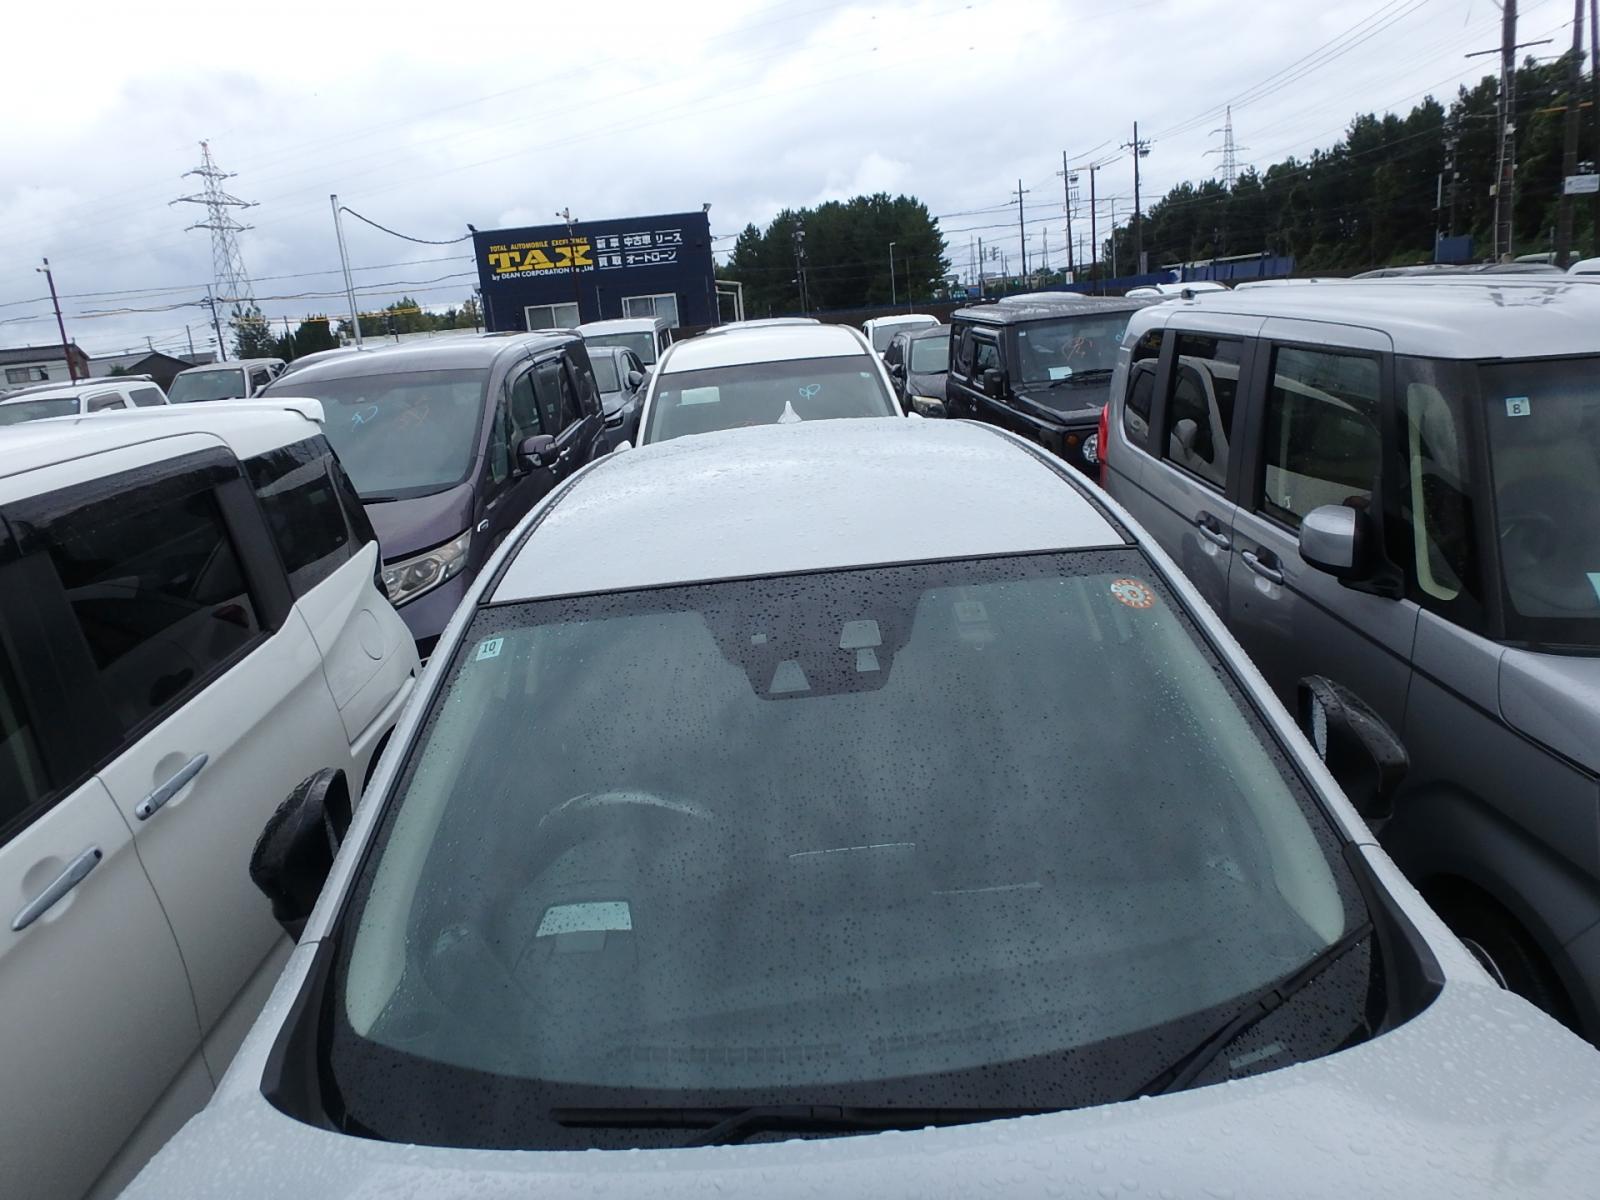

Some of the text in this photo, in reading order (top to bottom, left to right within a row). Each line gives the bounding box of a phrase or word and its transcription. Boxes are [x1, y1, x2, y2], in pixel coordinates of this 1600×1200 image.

[489, 244, 507, 253] TOTAL
[510, 240, 548, 250] AUTOMOBILE
[623, 235, 652, 247] 中古車
[655, 233, 682, 244] リース
[488, 244, 593, 274] TAX
[626, 251, 677, 265] オートローン
[491, 273, 501, 281] by
[501, 271, 521, 280] DEAN
[521, 267, 570, 278] CORPORATION
[1512, 403, 1521, 414] 8
[482, 641, 497, 653] 10
